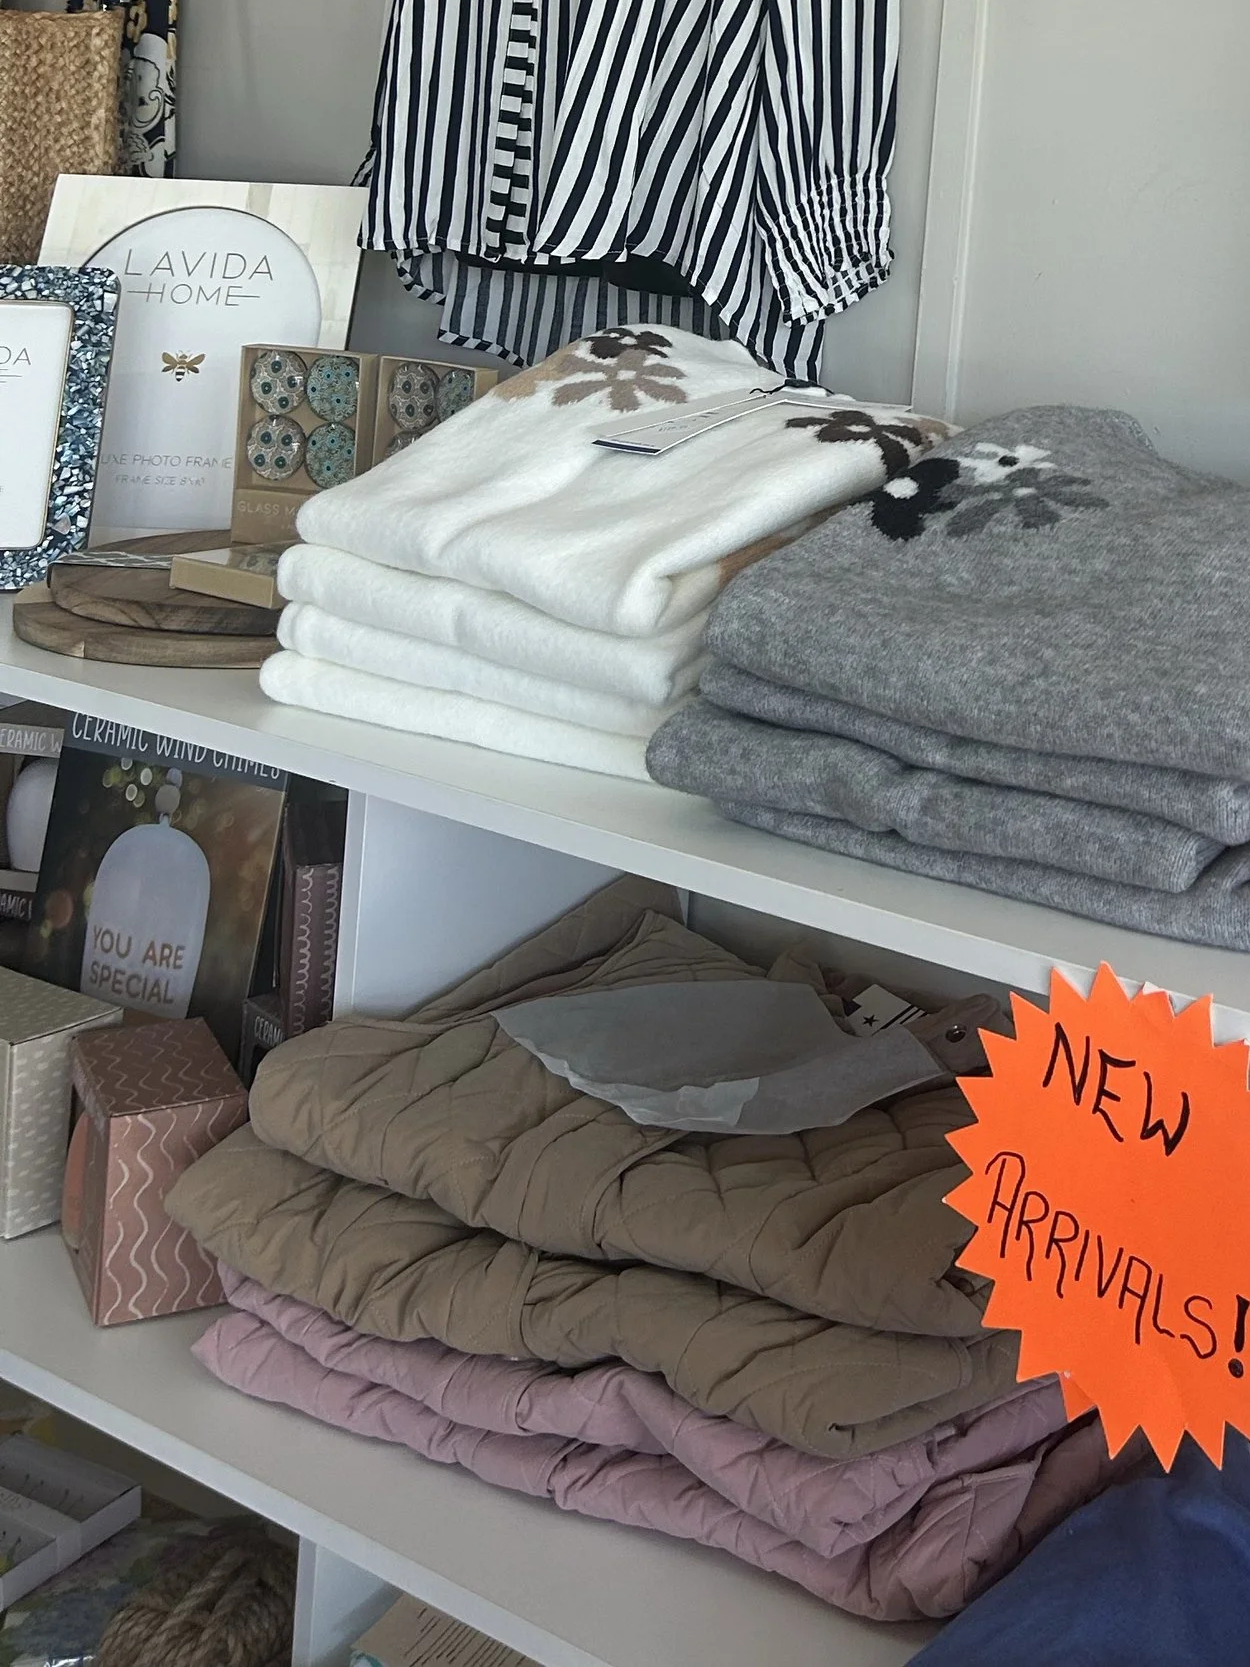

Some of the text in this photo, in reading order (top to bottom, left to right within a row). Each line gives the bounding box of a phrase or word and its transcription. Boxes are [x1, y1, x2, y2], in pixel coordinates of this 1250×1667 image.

[124, 248, 273, 281] LAVIDA
[126, 283, 261, 306] HOME
[131, 454, 181, 467] PHOTO
[185, 455, 233, 469] FRAME
[237, 500, 280, 516] GLASS
[72, 711, 148, 752] CERAMIC
[156, 733, 207, 763] WIND
[92, 924, 186, 970] YOU ARE
[89, 960, 175, 1005] SPECIAL
[1042, 1021, 1191, 1157] NEW
